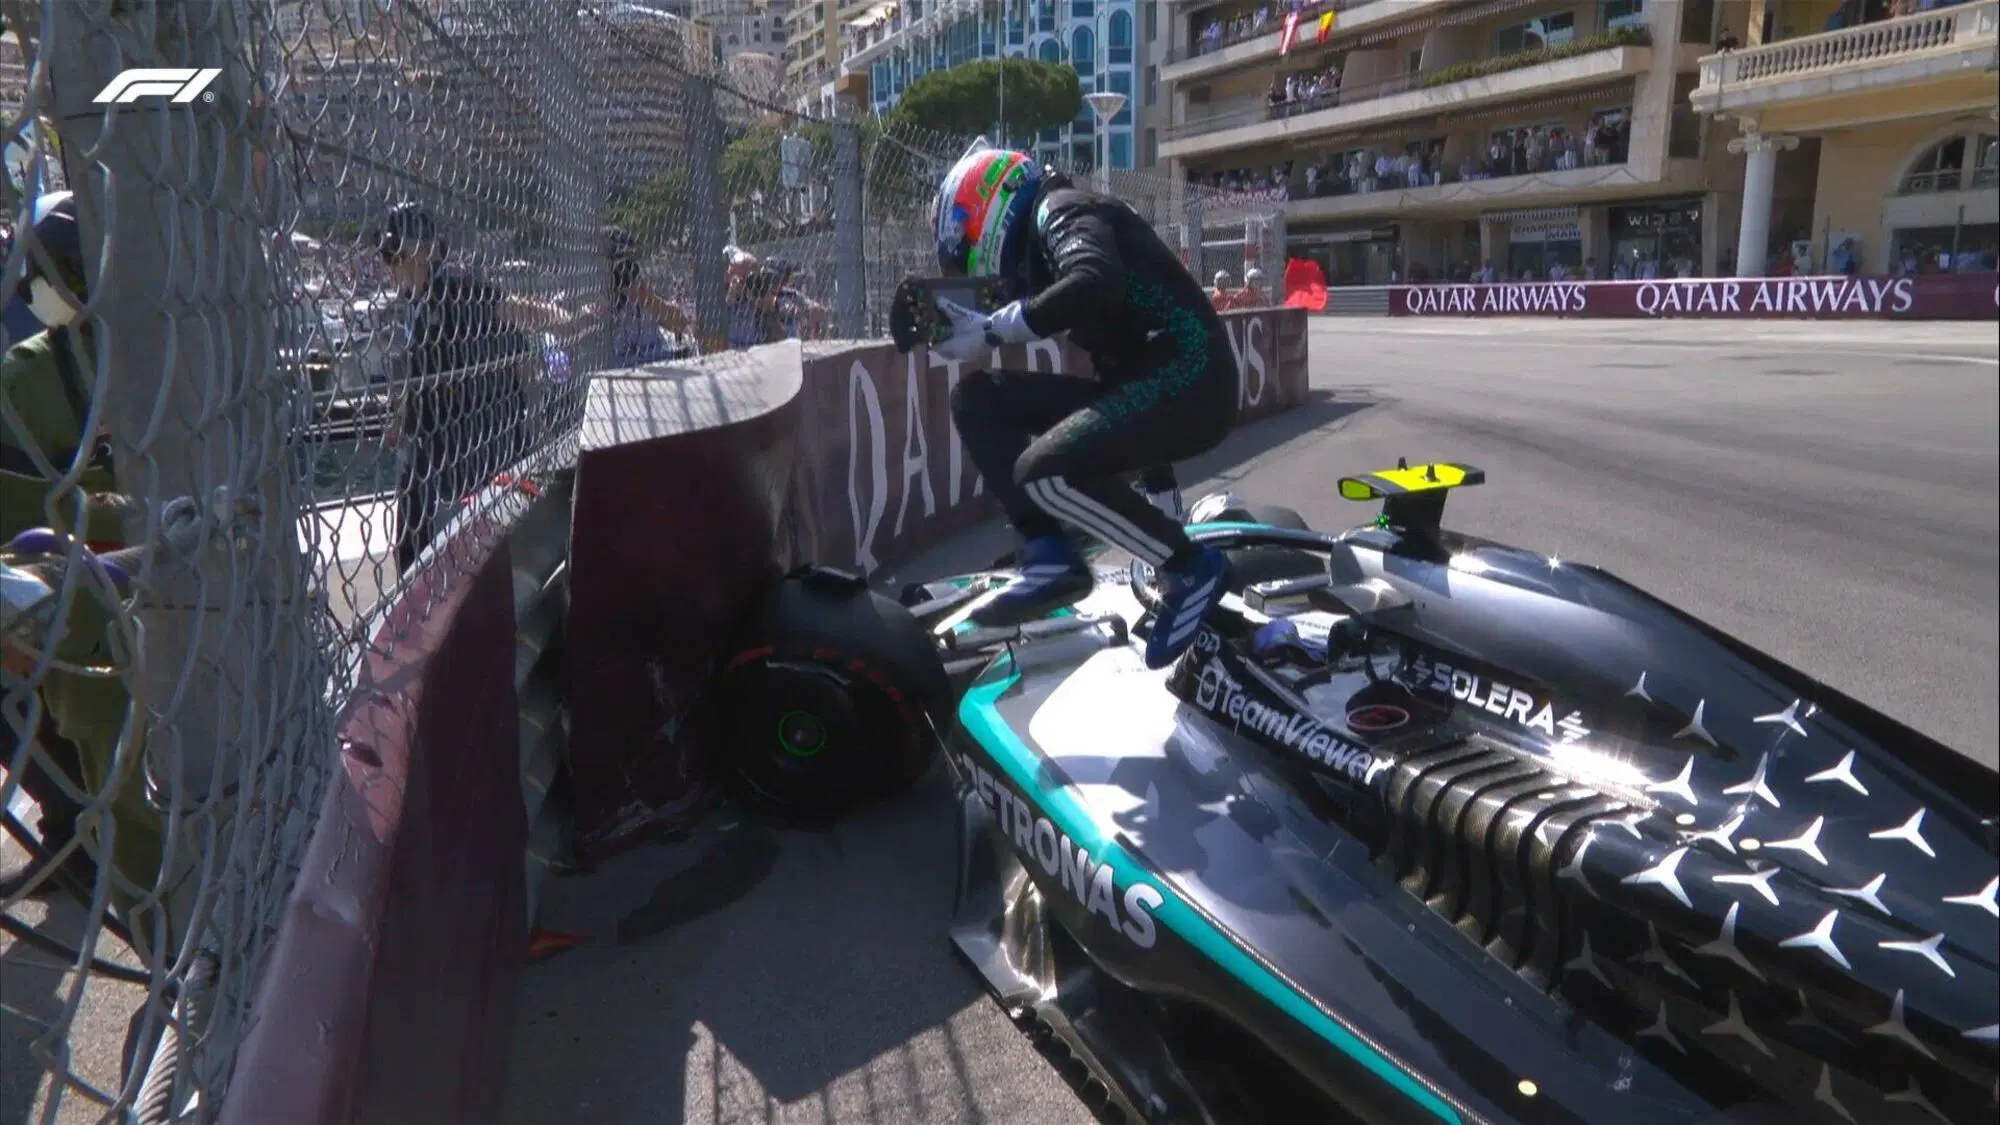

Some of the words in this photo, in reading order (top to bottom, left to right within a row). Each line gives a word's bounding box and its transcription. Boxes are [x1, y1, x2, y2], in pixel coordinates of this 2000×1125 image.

[1406, 287, 1476, 314] QATAR
[1482, 285, 1586, 312] AIRWAYS
[1636, 283, 1741, 315] QATAR
[1750, 279, 1913, 312] AIRWAYS
[1431, 664, 1555, 735] SOLERA
[1218, 680, 1394, 785] TeamViewer
